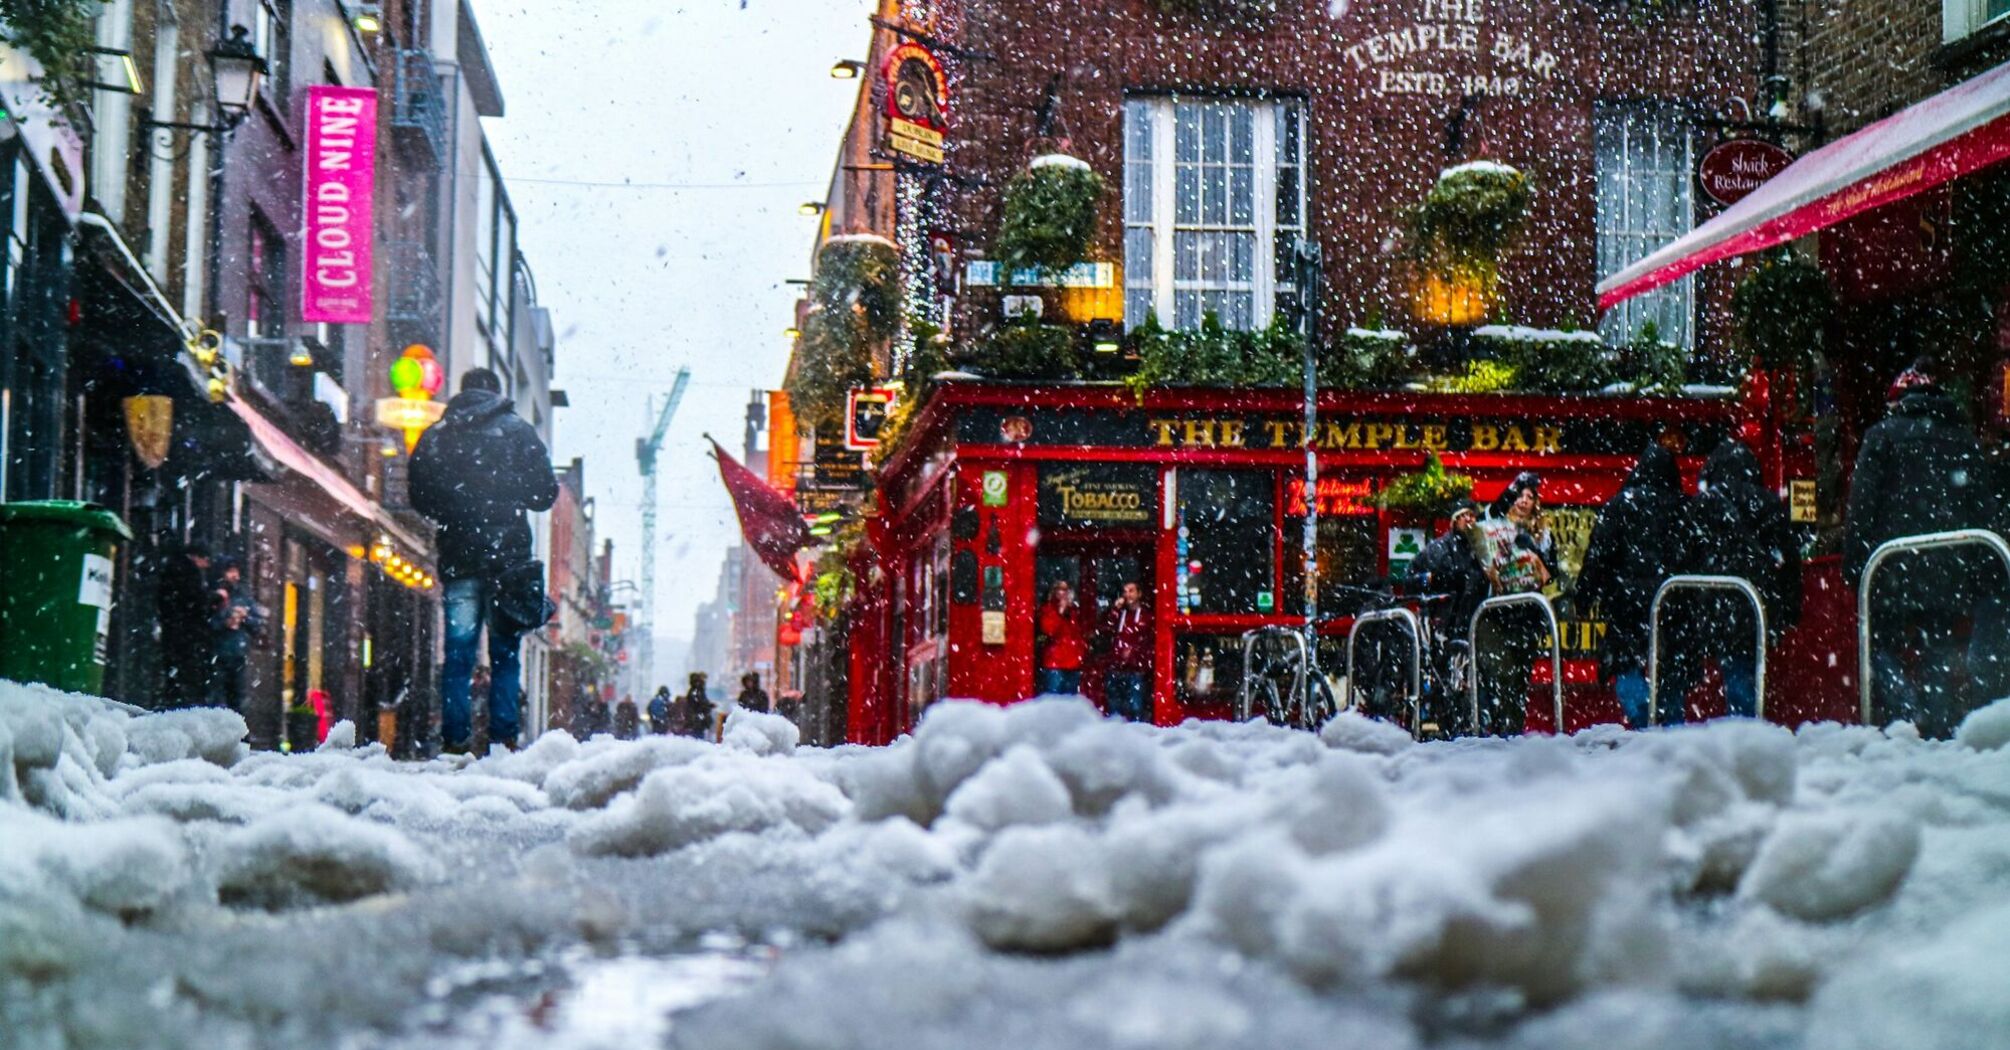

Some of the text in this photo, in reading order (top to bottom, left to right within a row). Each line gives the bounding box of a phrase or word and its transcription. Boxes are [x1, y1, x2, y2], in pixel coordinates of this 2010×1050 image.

[1424, 0, 1484, 22] THE
[1344, 24, 1557, 80] TEMPLE BAR
[319, 96, 364, 170] NINE
[316, 181, 358, 287] CLOUD
[1150, 419, 1561, 451] THE TEMPLE BAR
[1057, 485, 1140, 514] TOBACCO
